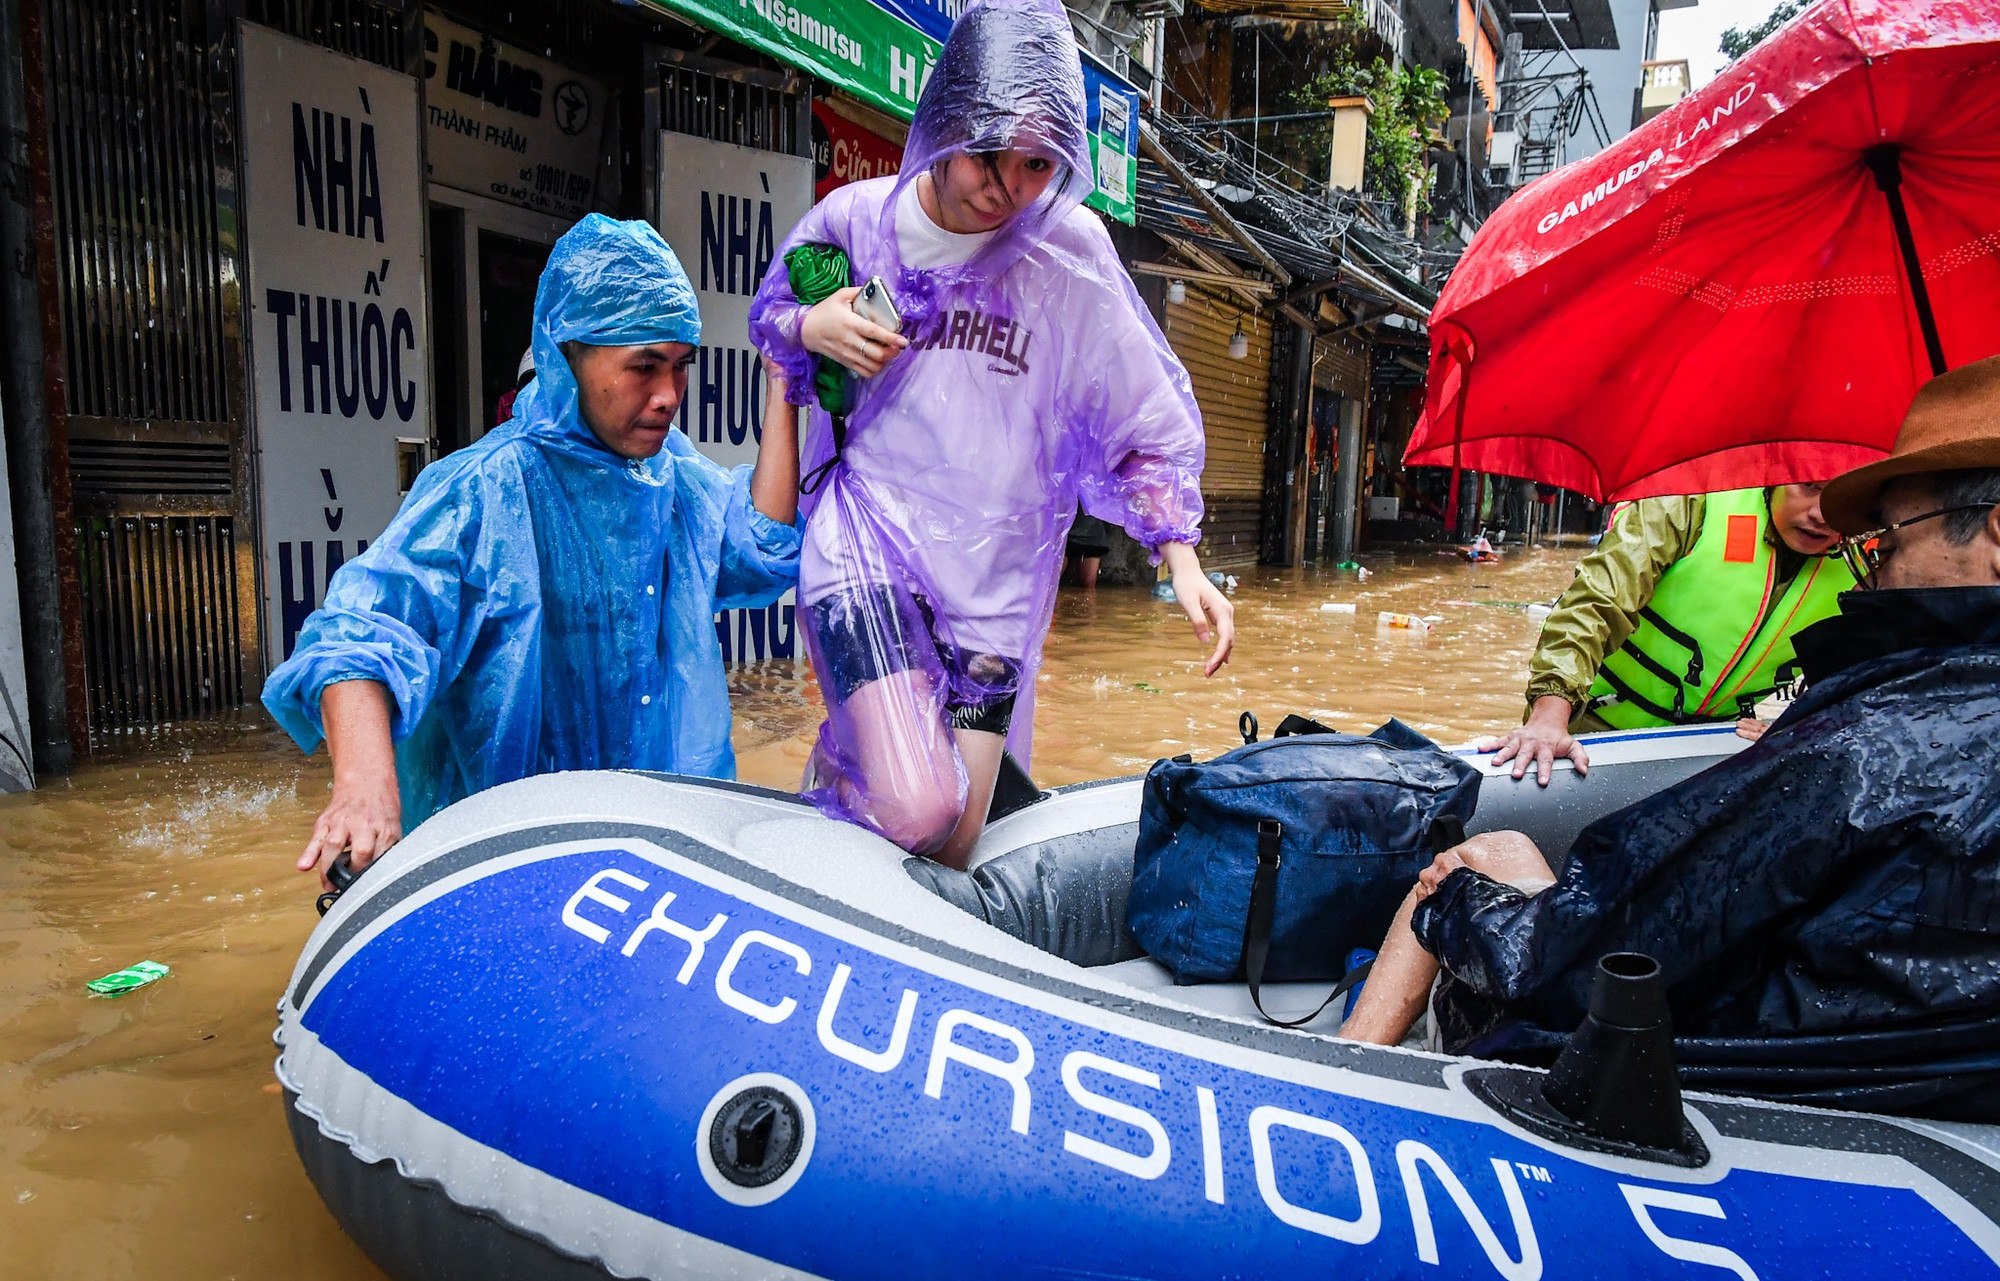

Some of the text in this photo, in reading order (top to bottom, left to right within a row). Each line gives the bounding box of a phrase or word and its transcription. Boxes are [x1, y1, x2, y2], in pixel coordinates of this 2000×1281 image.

[292, 86, 384, 243] NHÀ
[428, 105, 480, 139] THÀNH
[833, 138, 872, 182] Cửa
[1537, 82, 1756, 234] GAMUDA LAND
[701, 172, 774, 296] NHÀ
[266, 259, 417, 422] THUỐC
[562, 868, 1544, 1281] EXCURSION
